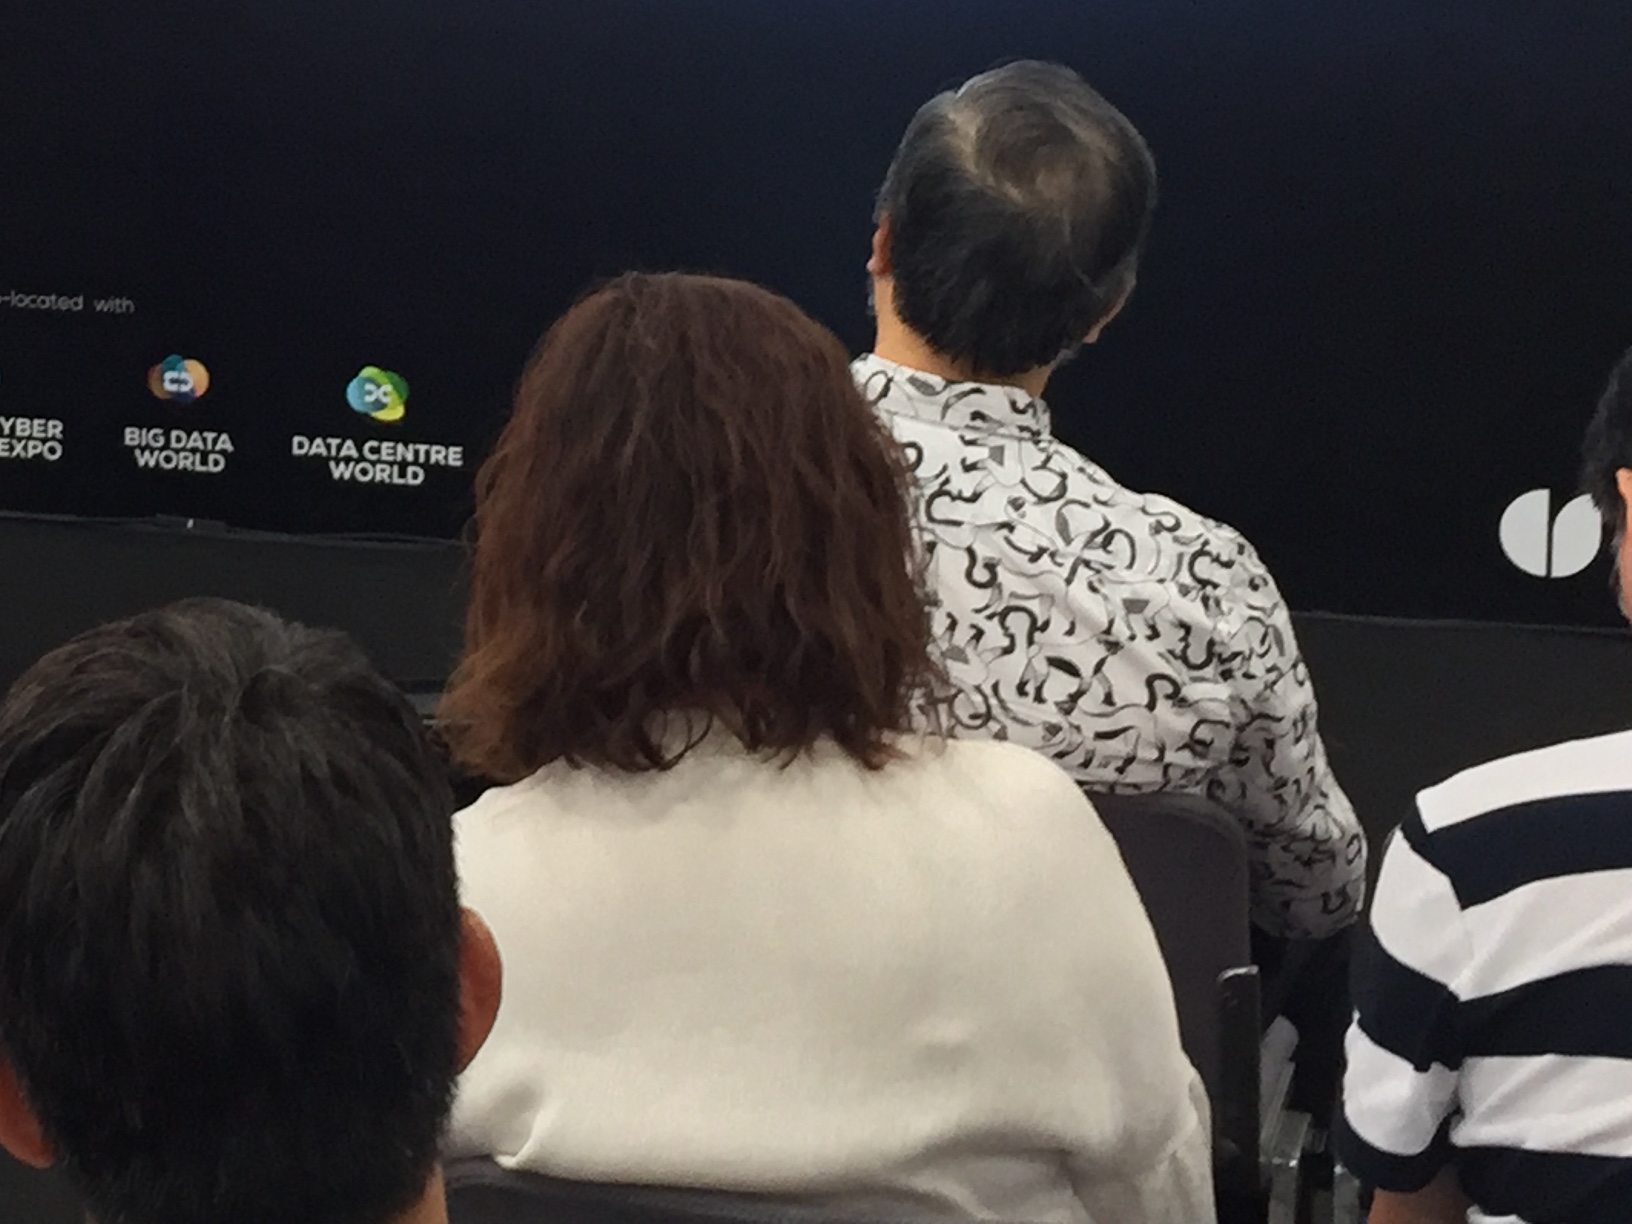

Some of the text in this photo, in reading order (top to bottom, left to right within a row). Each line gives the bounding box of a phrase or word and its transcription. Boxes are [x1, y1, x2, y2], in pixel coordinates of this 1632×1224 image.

[94, 296, 135, 314] with
[124, 427, 234, 453] BIG DATA
[292, 436, 463, 467] DATA CENTRE
[134, 449, 226, 473] WORLD
[329, 461, 425, 486] WORLD
